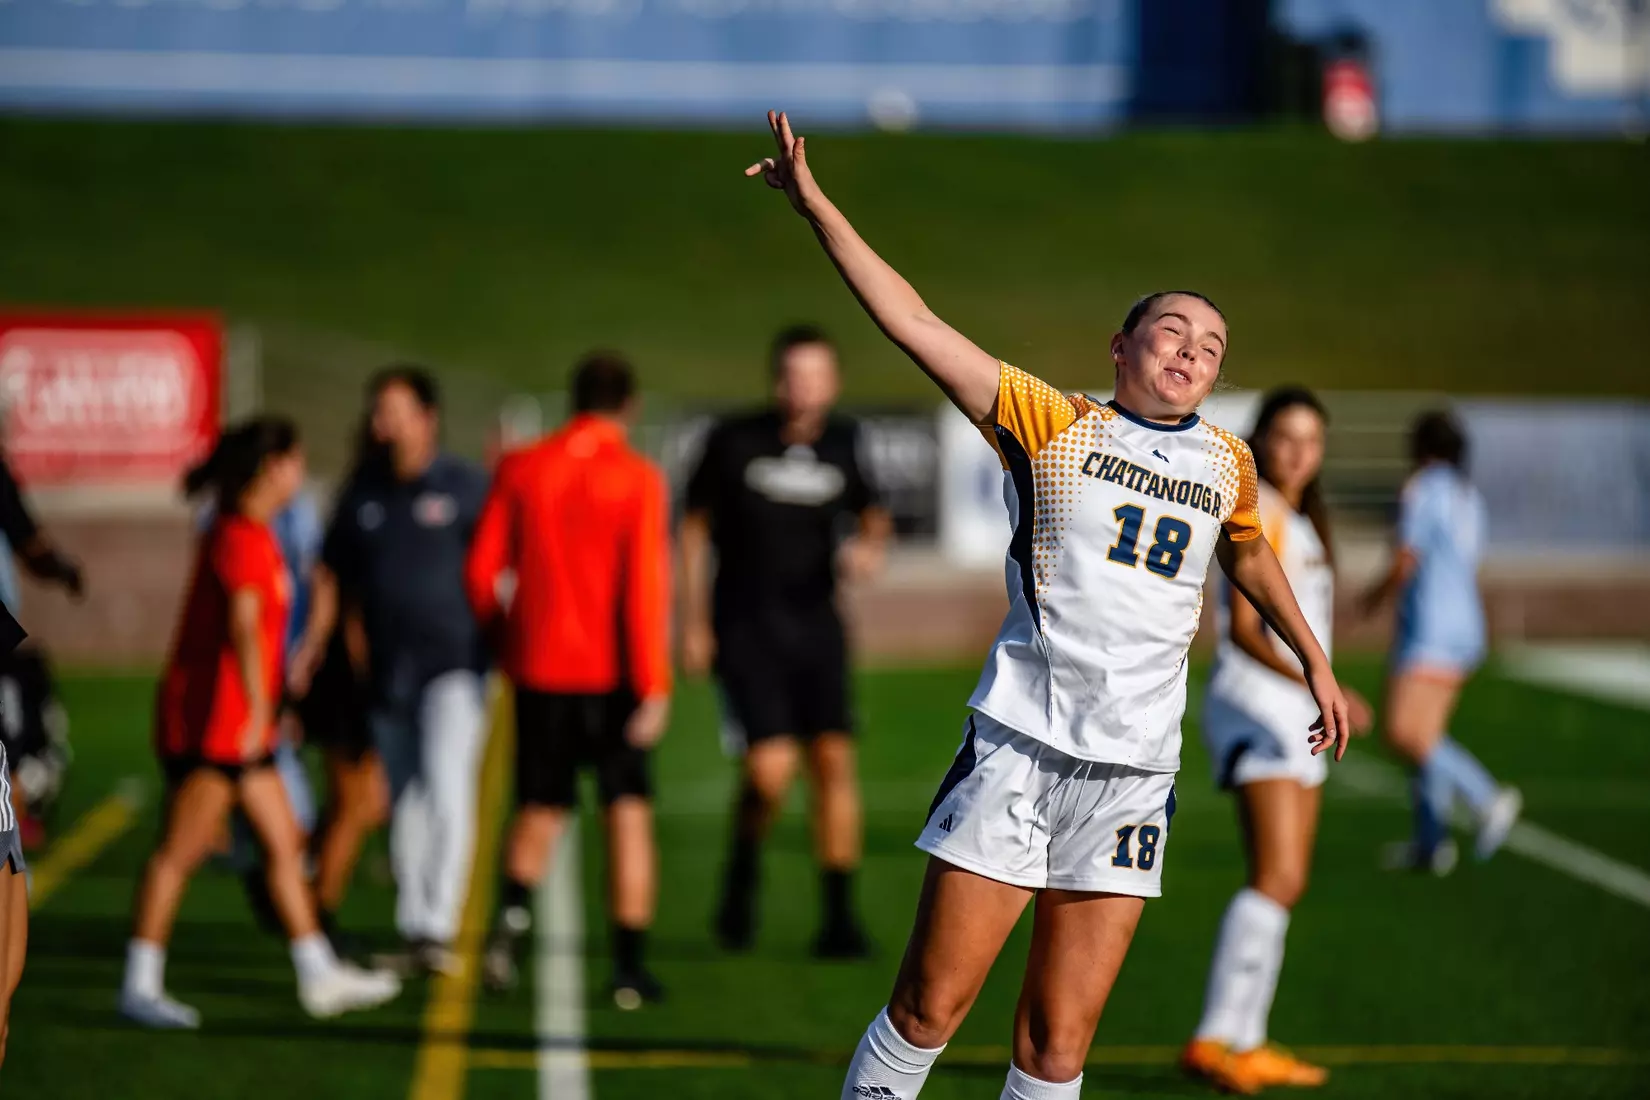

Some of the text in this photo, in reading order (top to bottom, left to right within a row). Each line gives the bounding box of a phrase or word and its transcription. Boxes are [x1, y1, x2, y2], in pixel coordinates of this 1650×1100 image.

[1081, 451, 1222, 519] CHATTANOOGA
[1106, 502, 1192, 581] 18
[1111, 823, 1161, 872] 18
